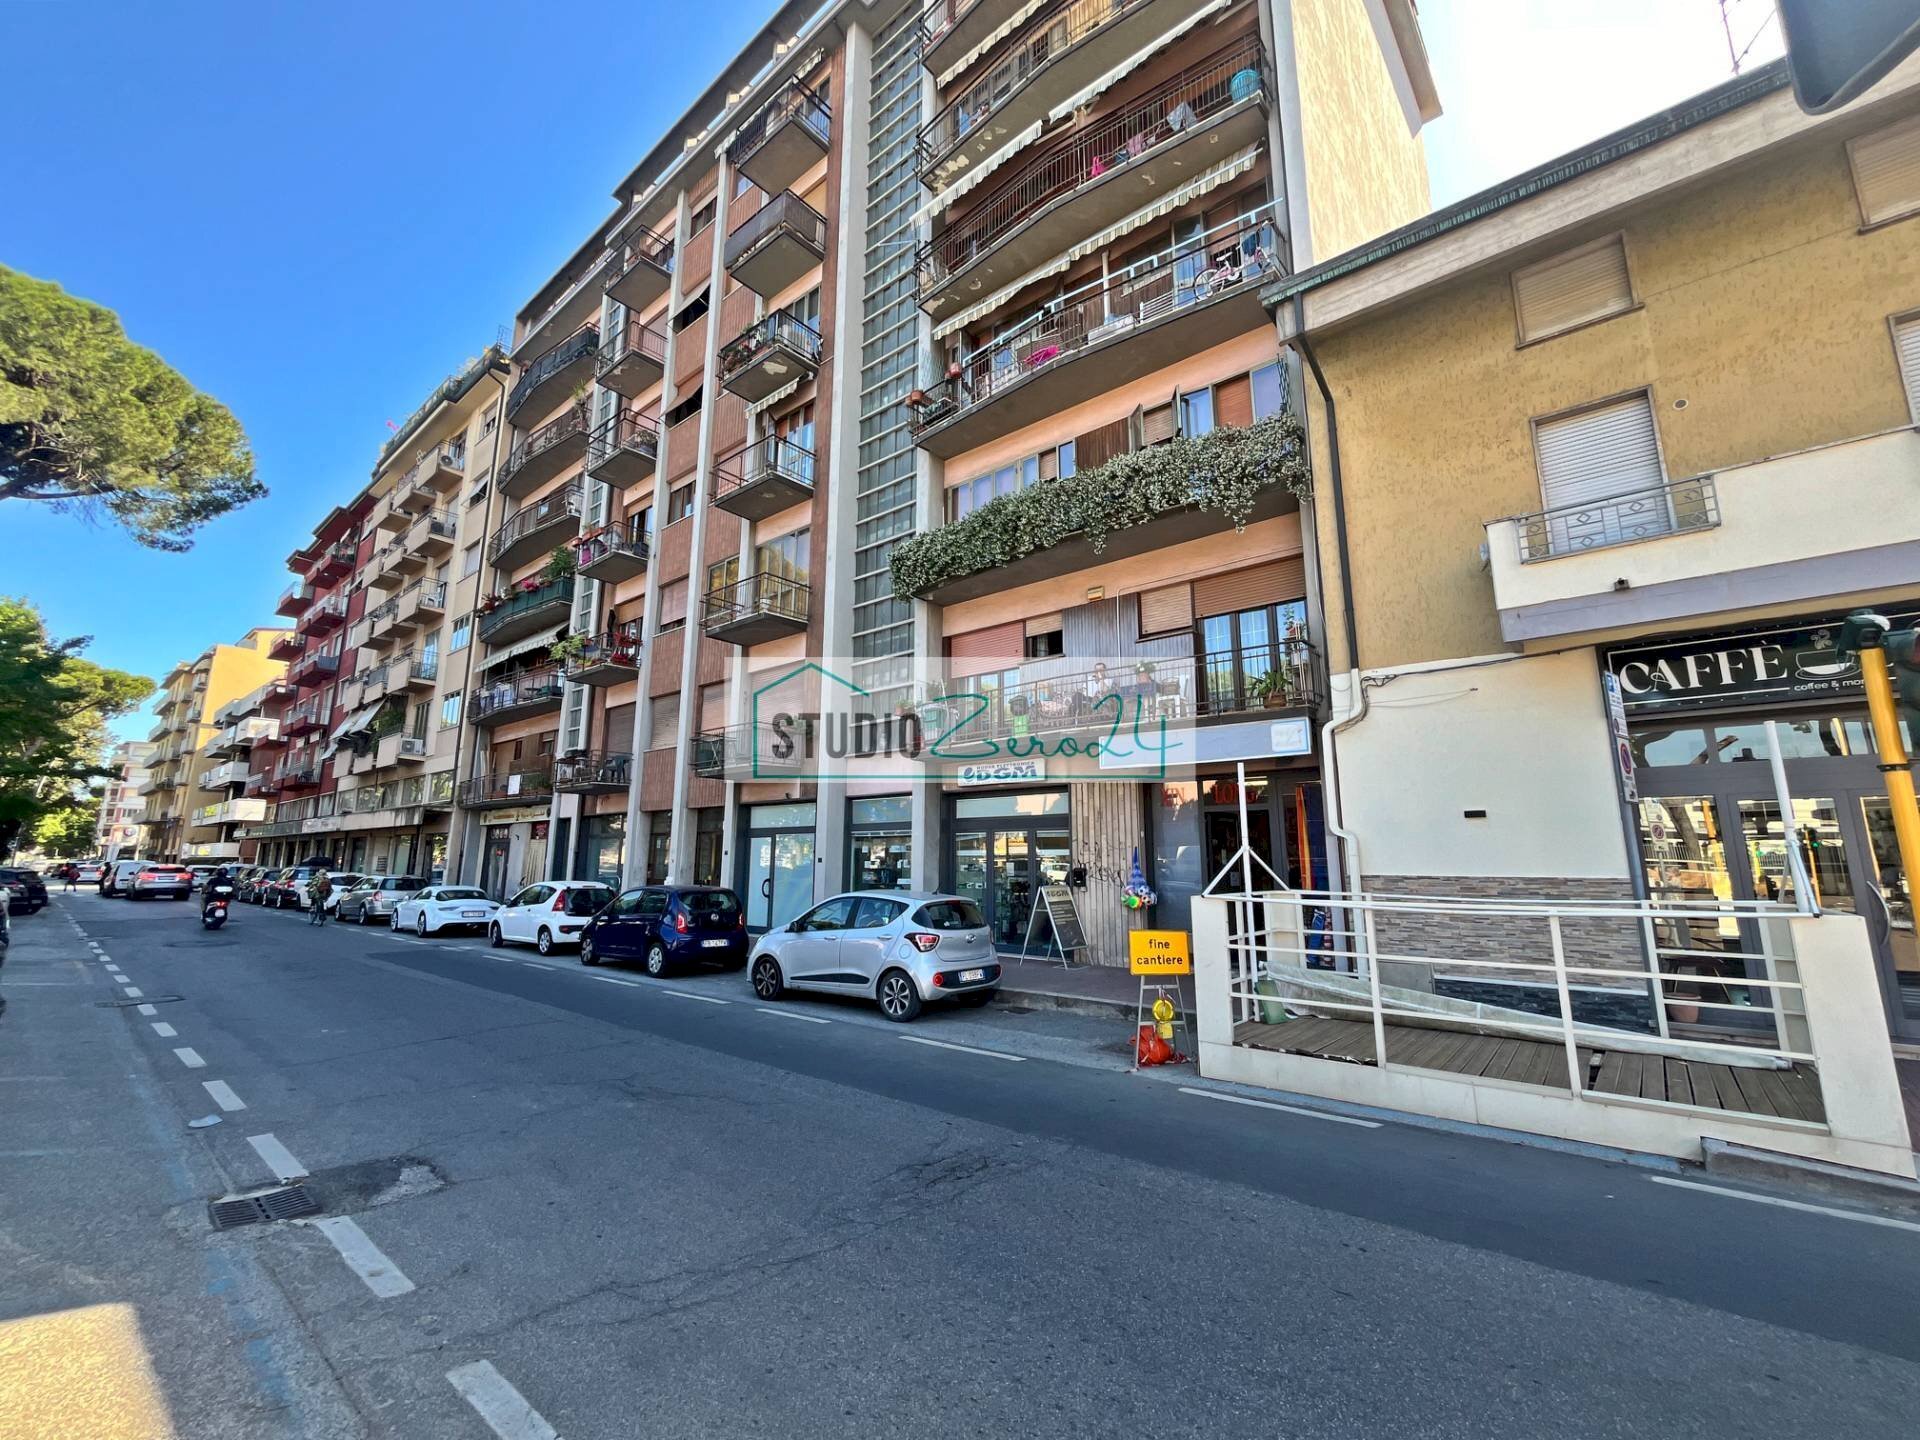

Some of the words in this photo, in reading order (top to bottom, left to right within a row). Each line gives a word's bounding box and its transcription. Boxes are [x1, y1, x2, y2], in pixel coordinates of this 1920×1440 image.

[1619, 640, 1788, 695] CAFFÈ
[1794, 681, 1829, 692] coffee
[1831, 680, 1840, 688] &
[1148, 938, 1170, 949] fine
[1136, 954, 1183, 965] cantiere
